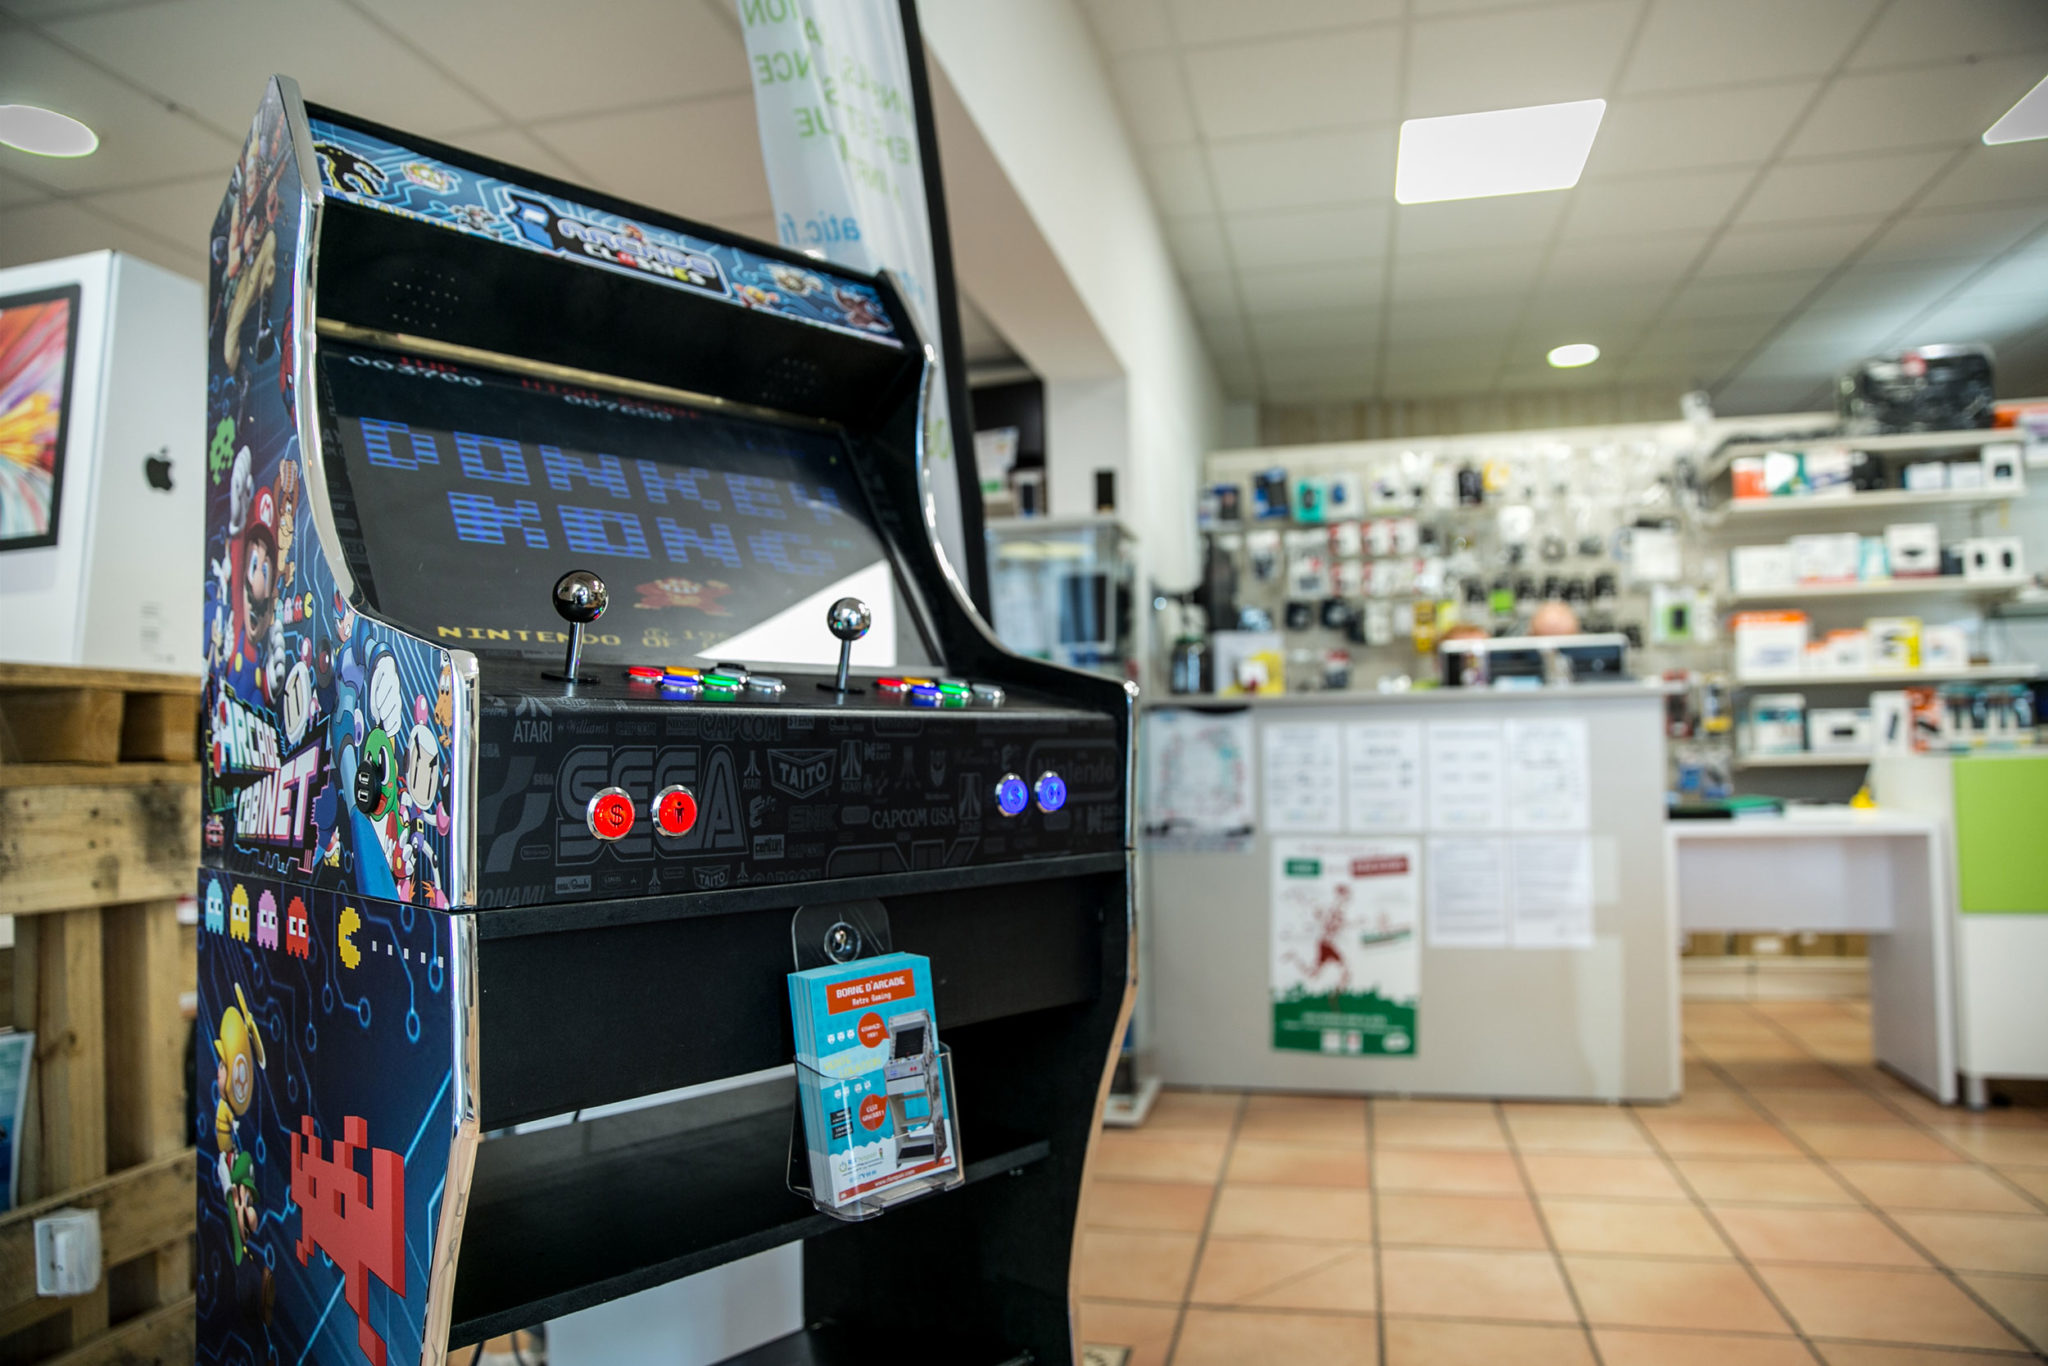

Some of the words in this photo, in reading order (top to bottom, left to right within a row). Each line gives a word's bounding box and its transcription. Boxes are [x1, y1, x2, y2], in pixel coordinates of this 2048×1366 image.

[360, 417, 839, 526] DONKEY
[447, 491, 836, 576] KONG
[438, 626, 622, 646] NINTENDO
[219, 696, 281, 771] ARCADE
[512, 719, 552, 743] ATARI
[700, 715, 782, 741] CAPCOM
[778, 761, 827, 790] TAITO
[237, 746, 319, 841] CABINET
[556, 744, 750, 867] SEGA
[872, 808, 928, 829] CAPCOM
[930, 807, 957, 826] USA
[698, 871, 726, 888] TAITO
[836, 984, 864, 999] BORNE
[865, 975, 906, 993] D'ARCADE
